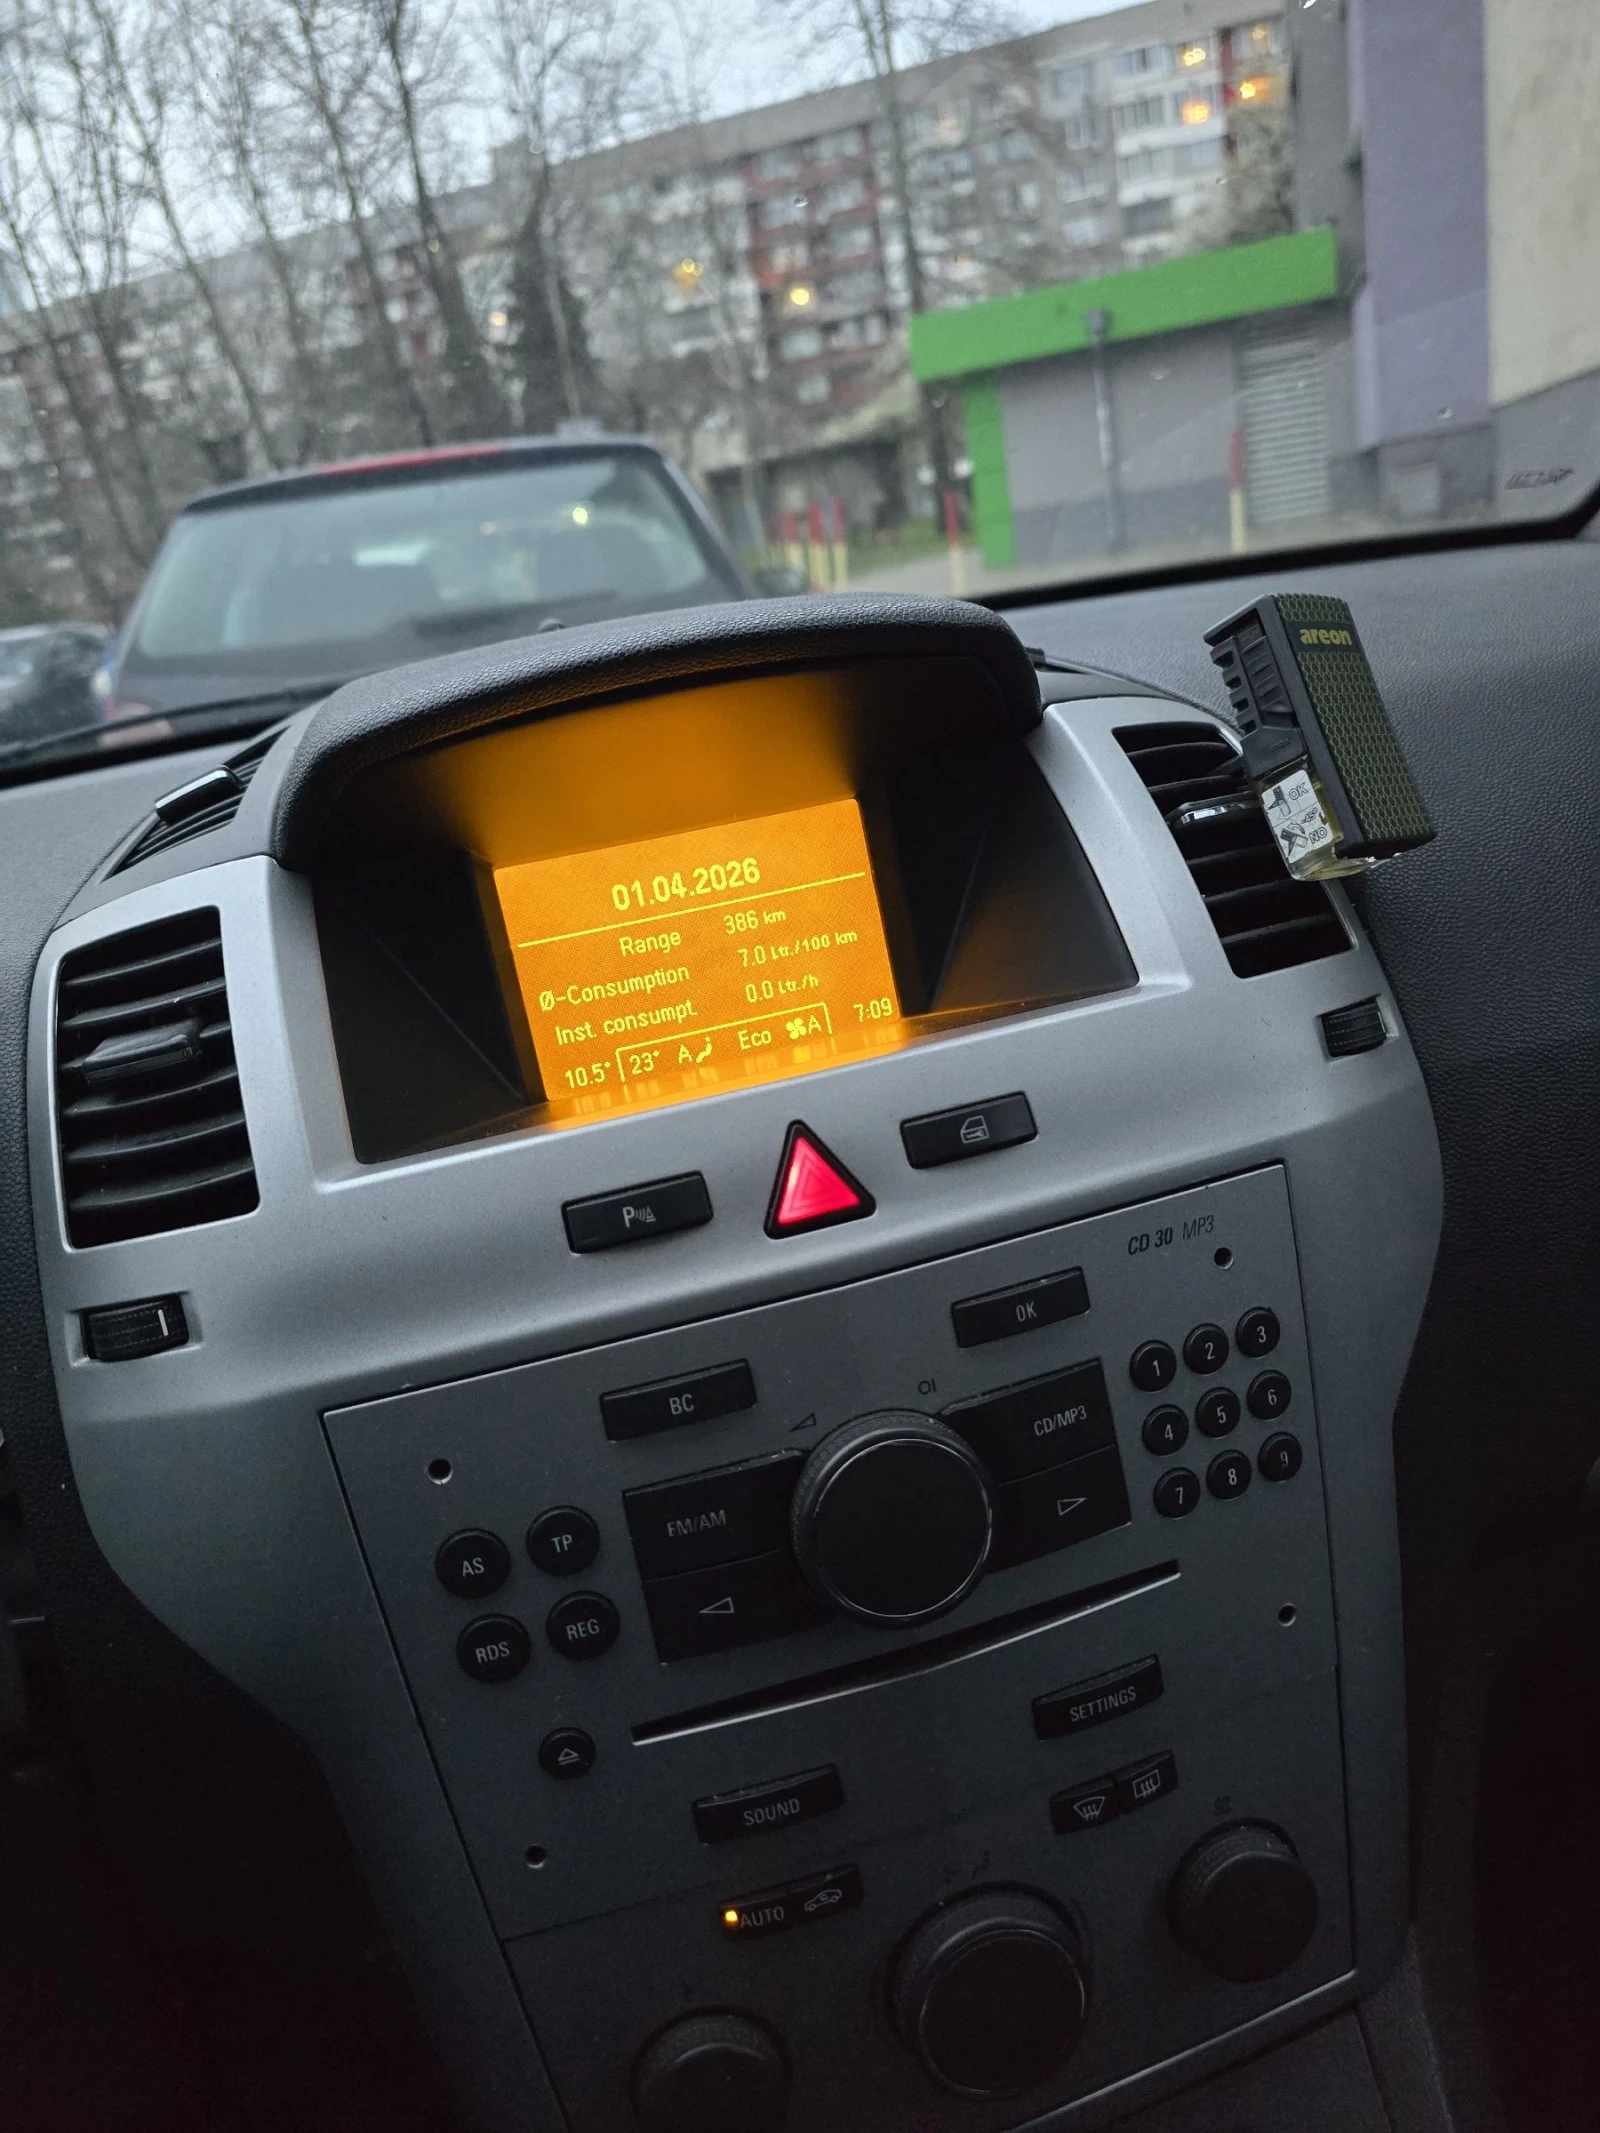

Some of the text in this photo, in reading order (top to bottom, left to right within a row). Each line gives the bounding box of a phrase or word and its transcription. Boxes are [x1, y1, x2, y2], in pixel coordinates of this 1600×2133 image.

[1300, 628, 1352, 646] areon
[1289, 782, 1309, 800] OK
[1308, 826, 1327, 844] NO
[612, 858, 760, 911] 01.04.2026
[619, 910, 786, 957] Range 386 km
[539, 931, 857, 1011] Ø-Consumption 7.0 Ltr./100 km
[555, 1016, 597, 1045] Inst.
[746, 980, 774, 1003] 0.0
[778, 974, 819, 994] Ltr./h
[565, 997, 893, 1089] 10.5° 23° A Eco A 7:09
[1127, 1215, 1214, 1255] CD 30 MP3
[1016, 1301, 1037, 1322] OK
[1256, 1326, 1267, 1343] 3
[1205, 1342, 1216, 1360] 2
[1152, 1359, 1160, 1377] 1
[668, 1393, 695, 1415] BC
[1267, 1389, 1277, 1405] 6
[1033, 1405, 1087, 1436] CD/MP3
[1216, 1406, 1227, 1424] 5
[1164, 1424, 1174, 1441] 4
[1279, 1451, 1289, 1468] 9
[1228, 1468, 1238, 1485] 8
[1175, 1487, 1184, 1504] 7
[667, 1509, 727, 1537] FM/AM
[552, 1533, 573, 1554] TP
[461, 1556, 485, 1577] AS
[566, 1618, 600, 1641] REG
[475, 1641, 510, 1664] RDS
[1070, 1685, 1136, 1722] SETTINGS
[744, 1798, 800, 1826] SOUND
[740, 1905, 785, 1928] AUTO
